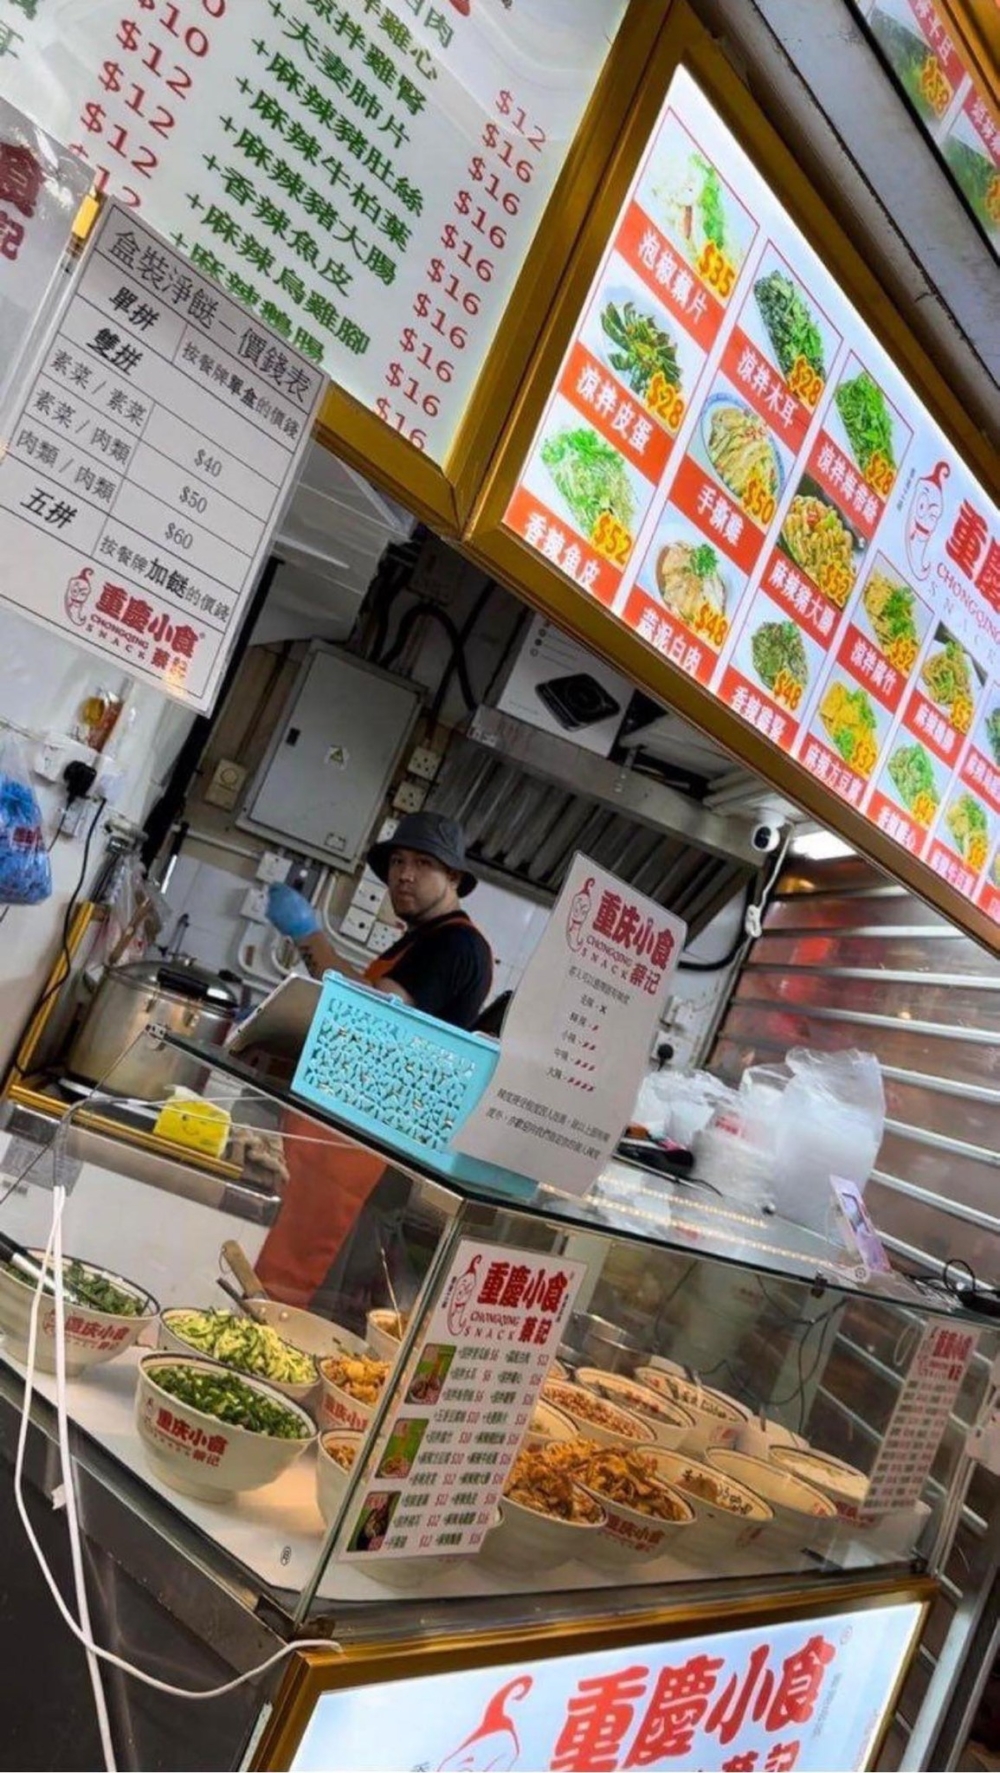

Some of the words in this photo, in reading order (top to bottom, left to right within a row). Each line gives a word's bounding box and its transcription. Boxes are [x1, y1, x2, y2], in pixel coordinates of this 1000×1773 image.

[116, 20, 192, 100] $12
[98, 60, 175, 140] $12
[496, 89, 547, 152] $12
[81, 101, 158, 179] $12
[482, 123, 534, 184] $16
[468, 156, 521, 216] $16
[454, 190, 507, 249] $16
[440, 224, 494, 283] $16
[698, 241, 735, 299] $35
[109, 286, 161, 332] 單拼
[427, 258, 482, 316] $16
[413, 293, 468, 350] $16
[86, 327, 144, 377] 雙拼
[399, 327, 455, 384] $16
[385, 362, 441, 418] $16
[646, 372, 685, 431] $28
[791, 357, 824, 407] $28
[194, 448, 223, 478] $40
[866, 452, 896, 496] $28
[19, 487, 78, 530] 五拼
[179, 485, 208, 515] $50
[743, 476, 776, 525] $50
[165, 521, 194, 551] $60
[593, 511, 633, 566] $52
[95, 581, 200, 659] 重慶小食
[694, 603, 729, 647] $48
[592, 889, 675, 971] 重庆小食
[477, 1262, 569, 1314] 重慶小食
[550, 1634, 836, 1771] 重慶小食
